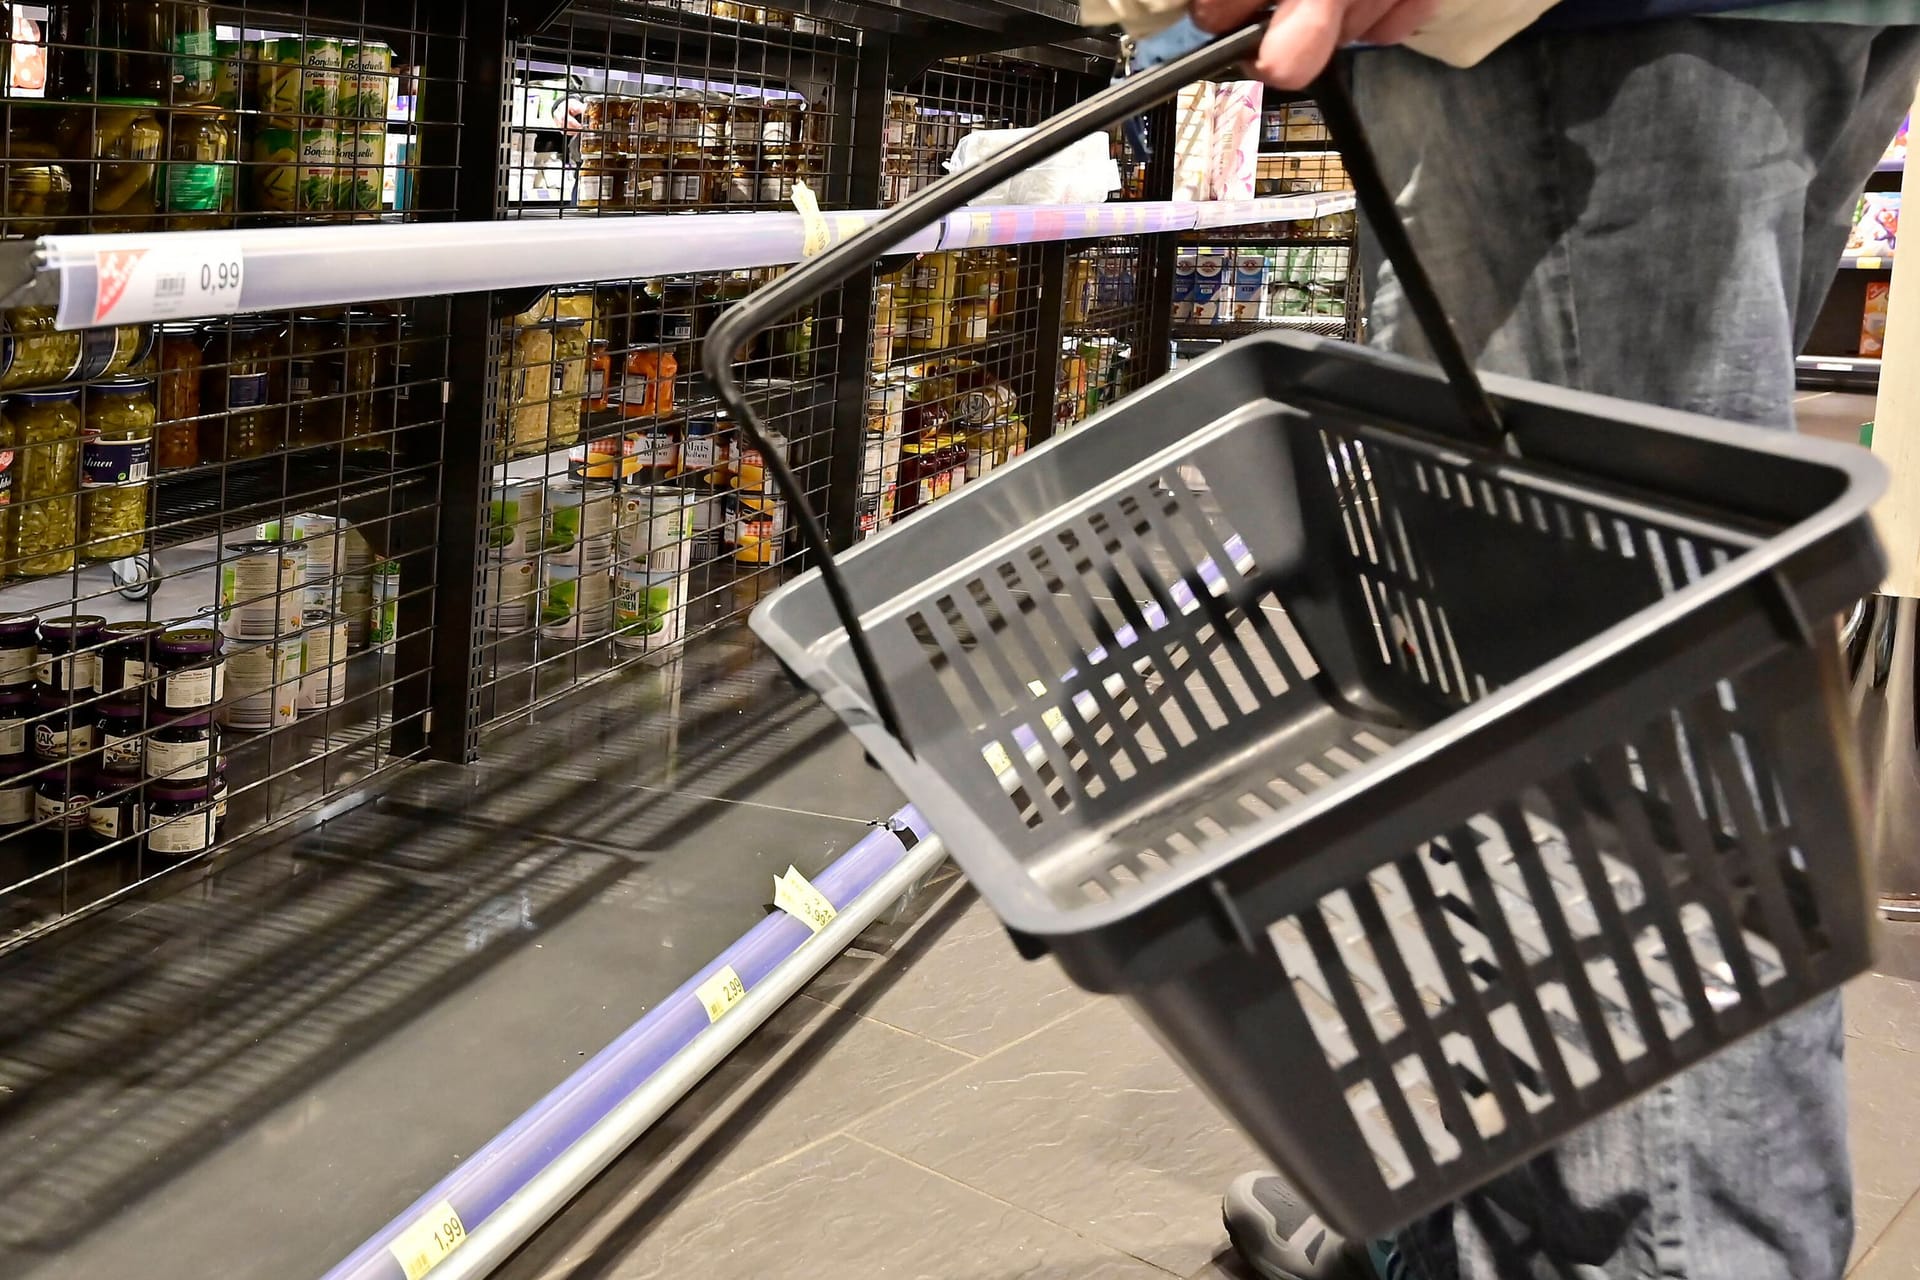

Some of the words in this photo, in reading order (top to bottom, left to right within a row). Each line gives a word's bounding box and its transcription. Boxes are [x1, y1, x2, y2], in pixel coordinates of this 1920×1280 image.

[201, 262, 240, 296] 0,99
[723, 977, 742, 1002] 2,99
[434, 1217, 462, 1251] 1,99
